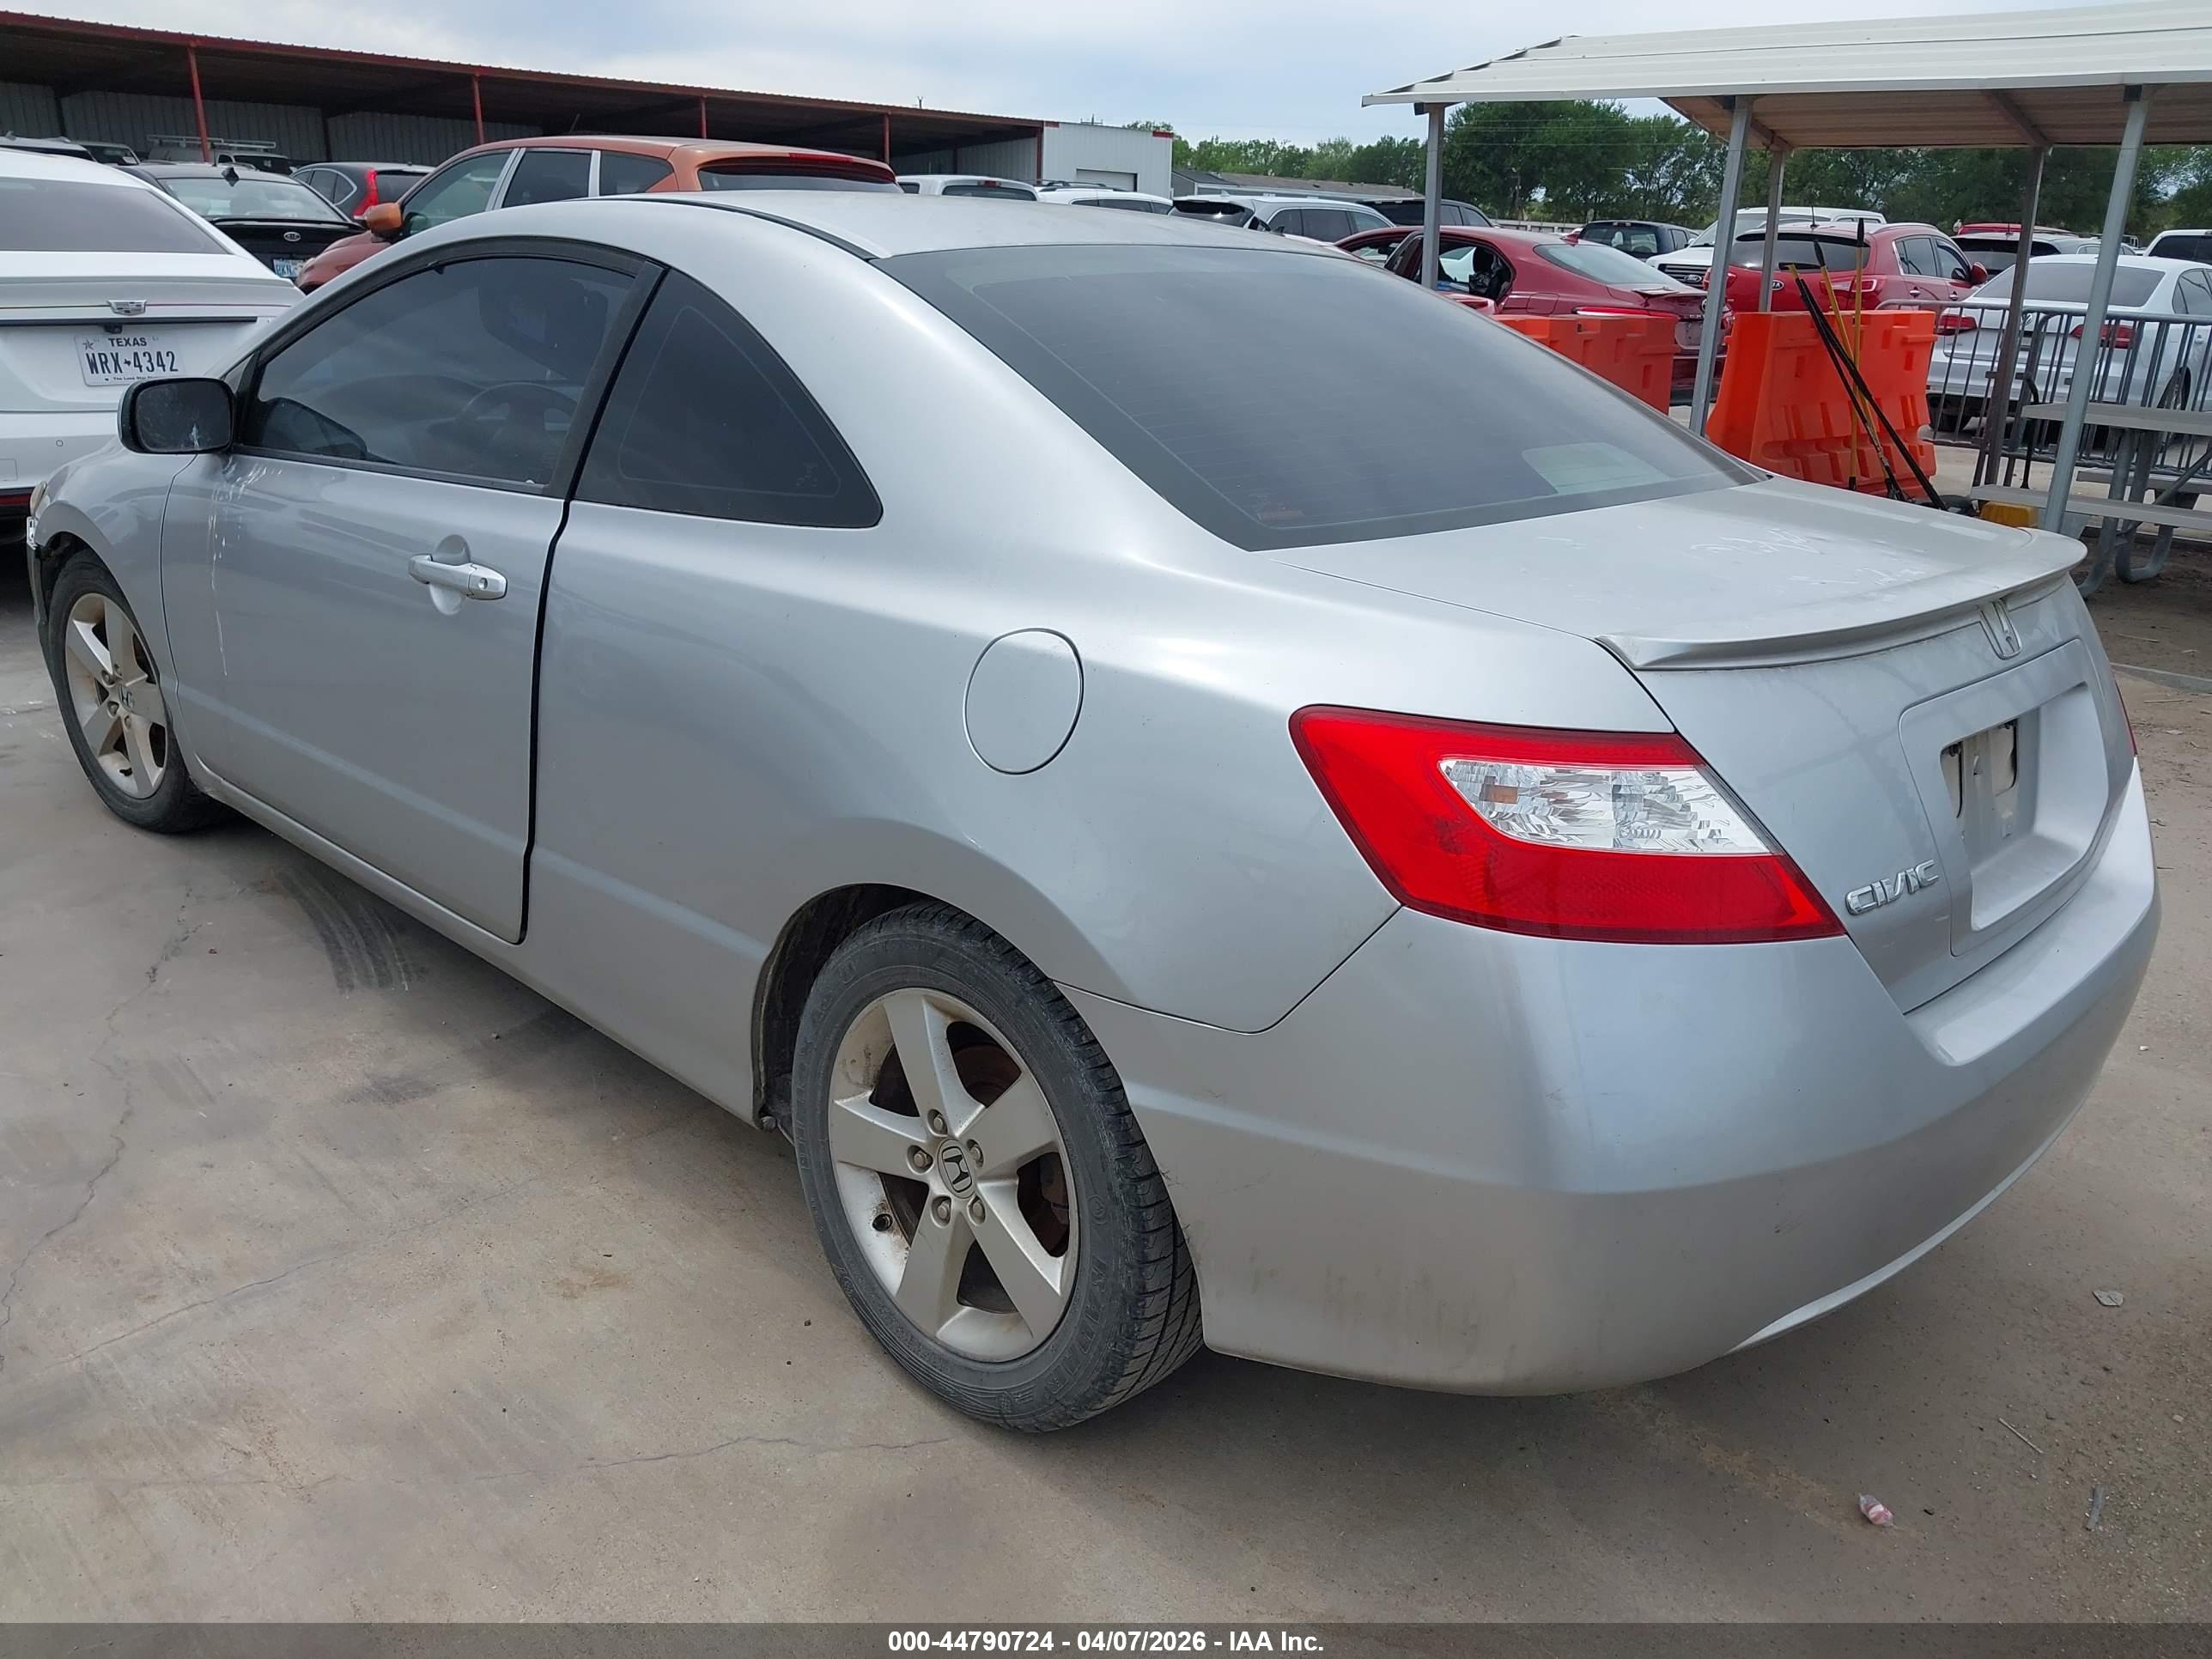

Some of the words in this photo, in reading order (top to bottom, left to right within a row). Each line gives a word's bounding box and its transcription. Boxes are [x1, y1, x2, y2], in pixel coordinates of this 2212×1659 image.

[108, 337, 148, 347] TEXAS
[133, 350, 179, 373] 4342
[1846, 860, 1939, 915] CIVIC
